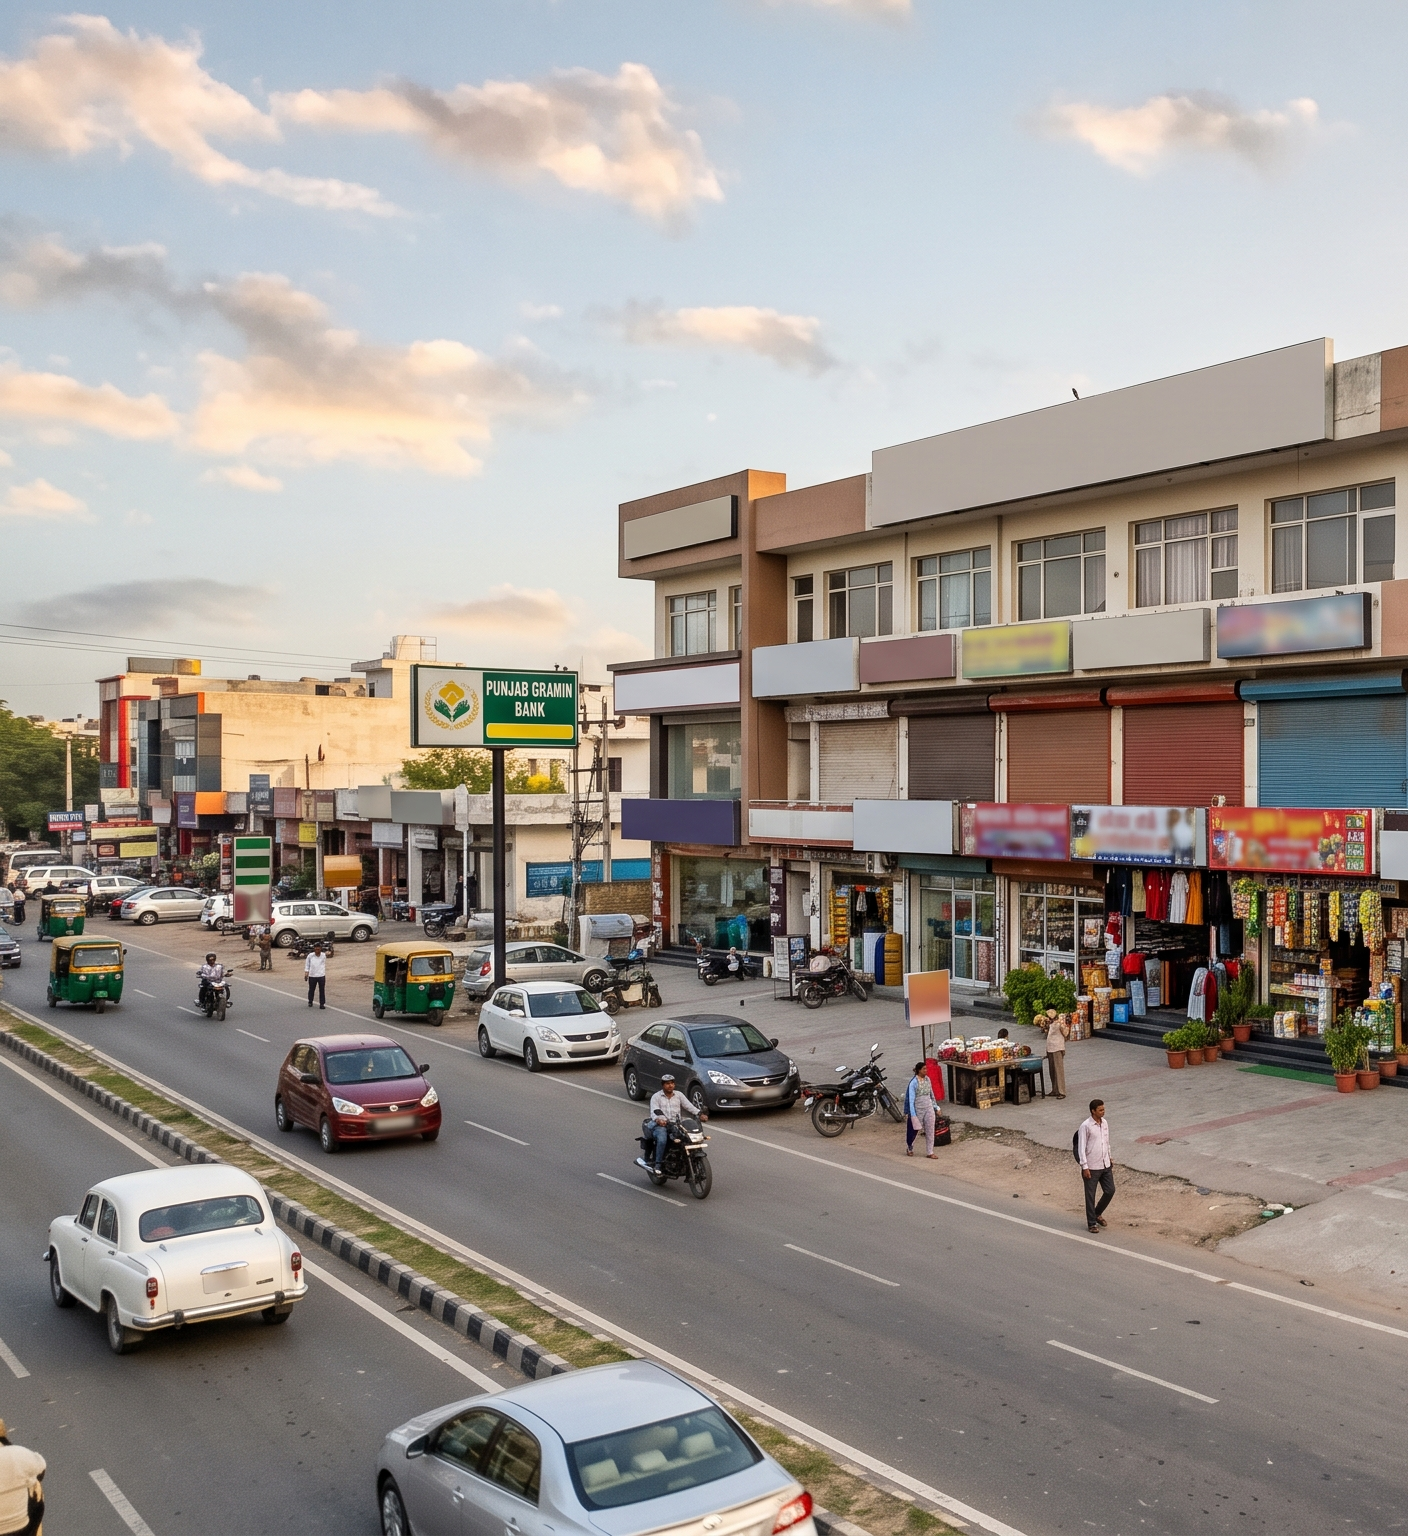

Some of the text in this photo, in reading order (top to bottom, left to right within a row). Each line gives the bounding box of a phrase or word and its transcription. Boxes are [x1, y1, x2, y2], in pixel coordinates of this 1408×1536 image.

[486, 680, 573, 698] PUNJAB GRAMIN
[515, 701, 546, 717] BANK
